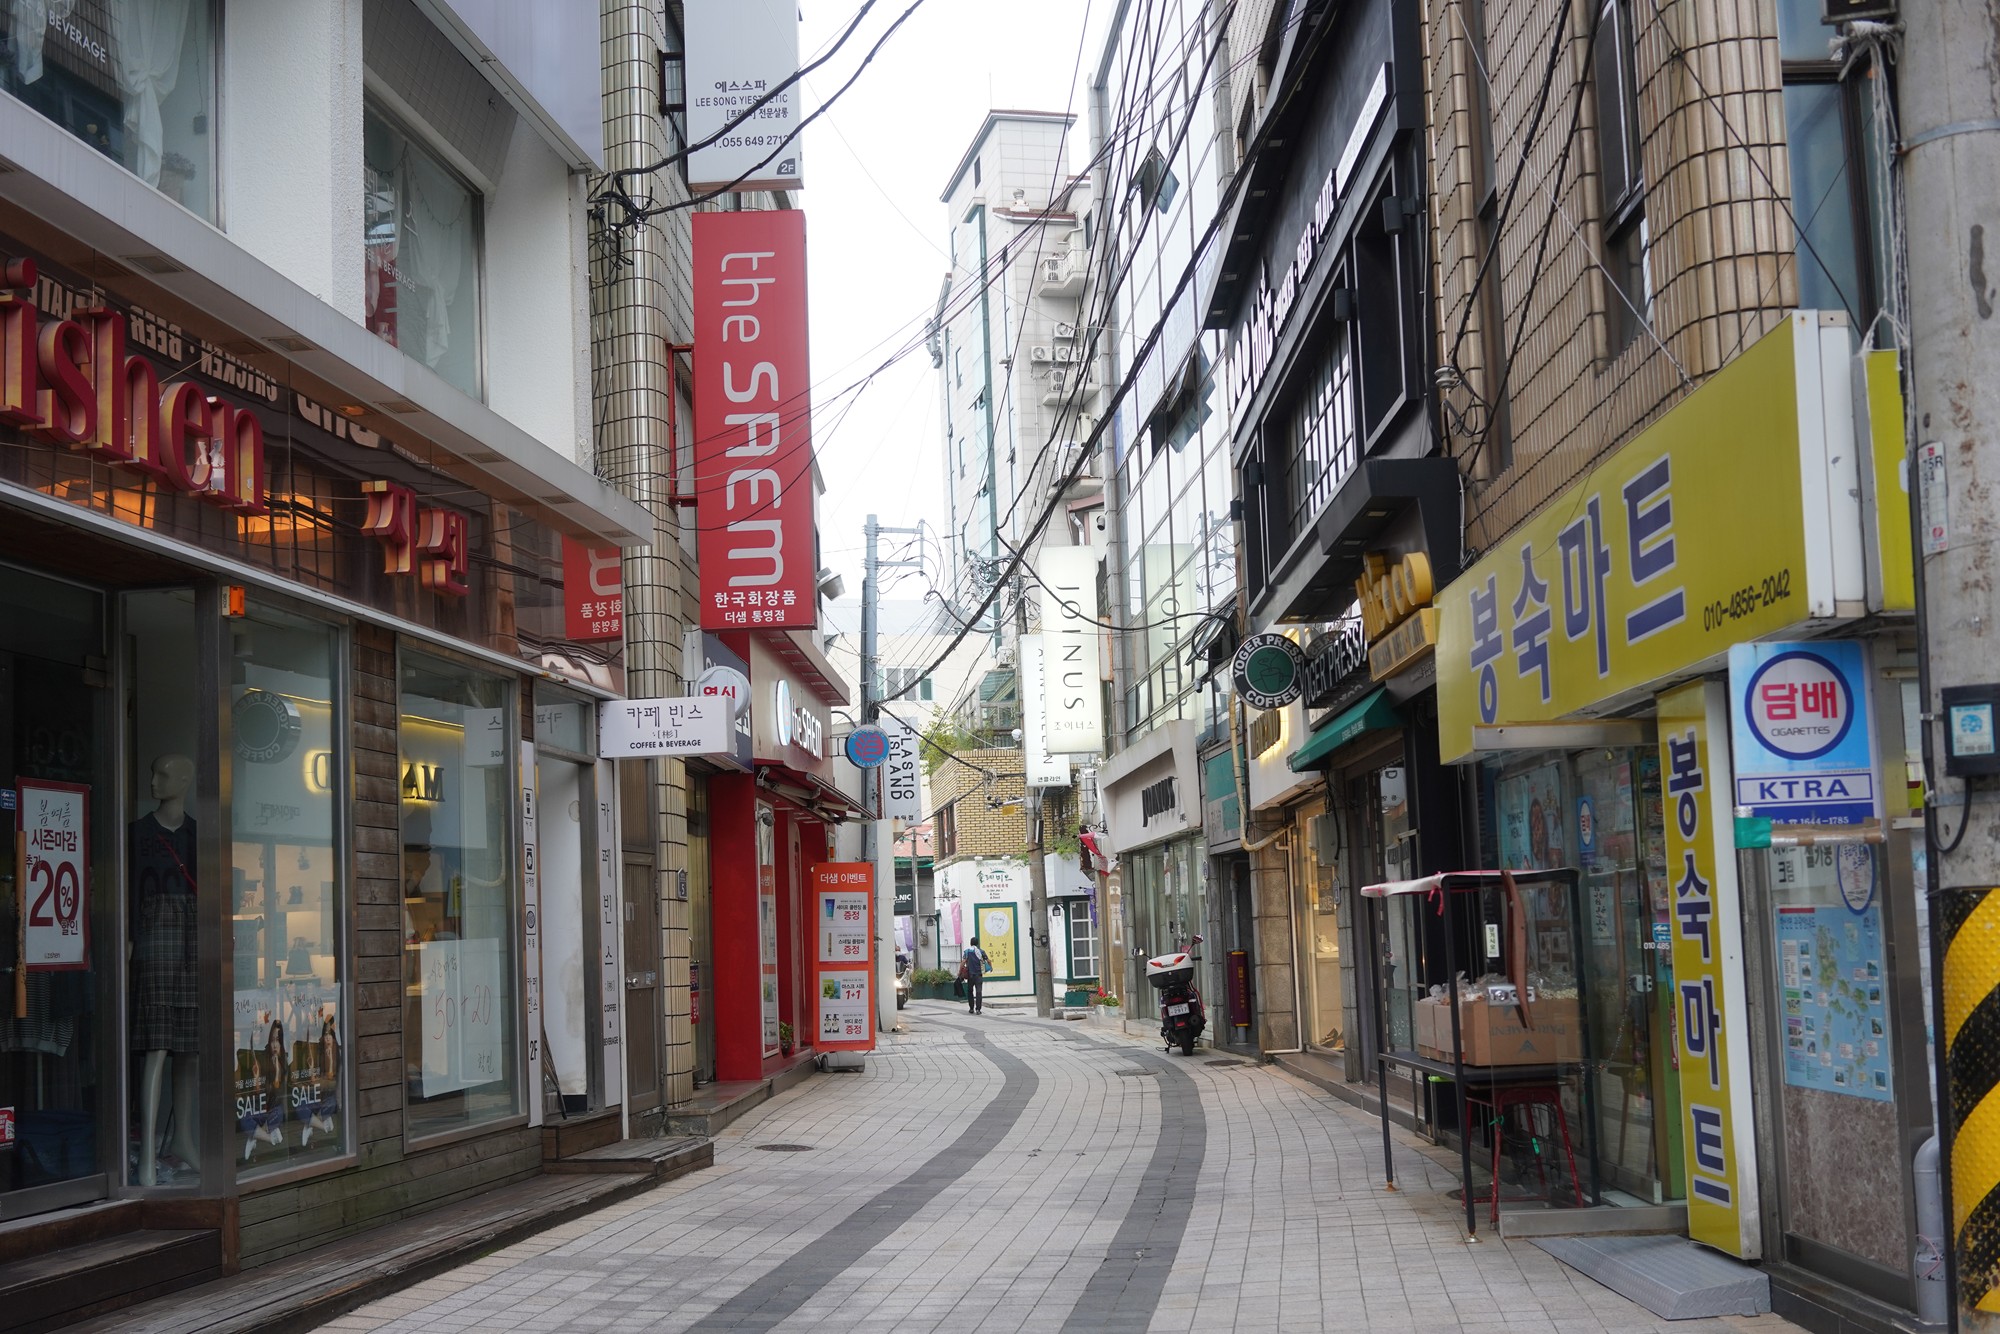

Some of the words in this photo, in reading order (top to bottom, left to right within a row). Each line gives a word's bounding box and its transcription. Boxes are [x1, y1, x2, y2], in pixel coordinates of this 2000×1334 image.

[48, 9, 107, 64] BEVERAGE
[714, 80, 767, 93] 에스스파
[695, 97, 711, 107] LEE
[713, 95, 737, 106] SONG
[759, 108, 789, 118] 전문살롱
[745, 135, 764, 146] 649
[781, 163, 794, 173] 2F
[720, 251, 776, 343] the
[1470, 453, 1685, 725] 봉숙마트
[1704, 569, 1791, 633] 010-4856-2042
[725, 610, 748, 624] 더샘
[751, 609, 785, 622] 통영점
[1055, 585, 1085, 710] JOINUS
[1234, 636, 1263, 678] YOGER
[1245, 685, 1301, 708] COFFEE
[1761, 681, 1838, 721] 담배
[626, 705, 661, 729] 카페
[668, 704, 704, 728] 빈스
[1053, 720, 1095, 731] 조이너스
[1771, 726, 1830, 737] CIGARETTES
[630, 741, 657, 750] COFFEE
[658, 740, 664, 748] &
[665, 739, 702, 748] BEVERAGE
[888, 734, 903, 800] ISLAND
[900, 725, 915, 800] PLASTIC
[1759, 779, 1850, 801] KTRA
[31, 828, 77, 852] 시즌마감
[820, 873, 838, 884] 더샘
[840, 873, 867, 884] 이벤트
[843, 911, 860, 921] 증정
[843, 945, 860, 955] 증정
[1668, 725, 1733, 1206] 봉숙마트
[846, 989, 861, 999] 1+1
[845, 1025, 862, 1034] 증정
[529, 1040, 538, 1061] 2F
[236, 1093, 267, 1120] SALE
[291, 1083, 321, 1109] SALE
